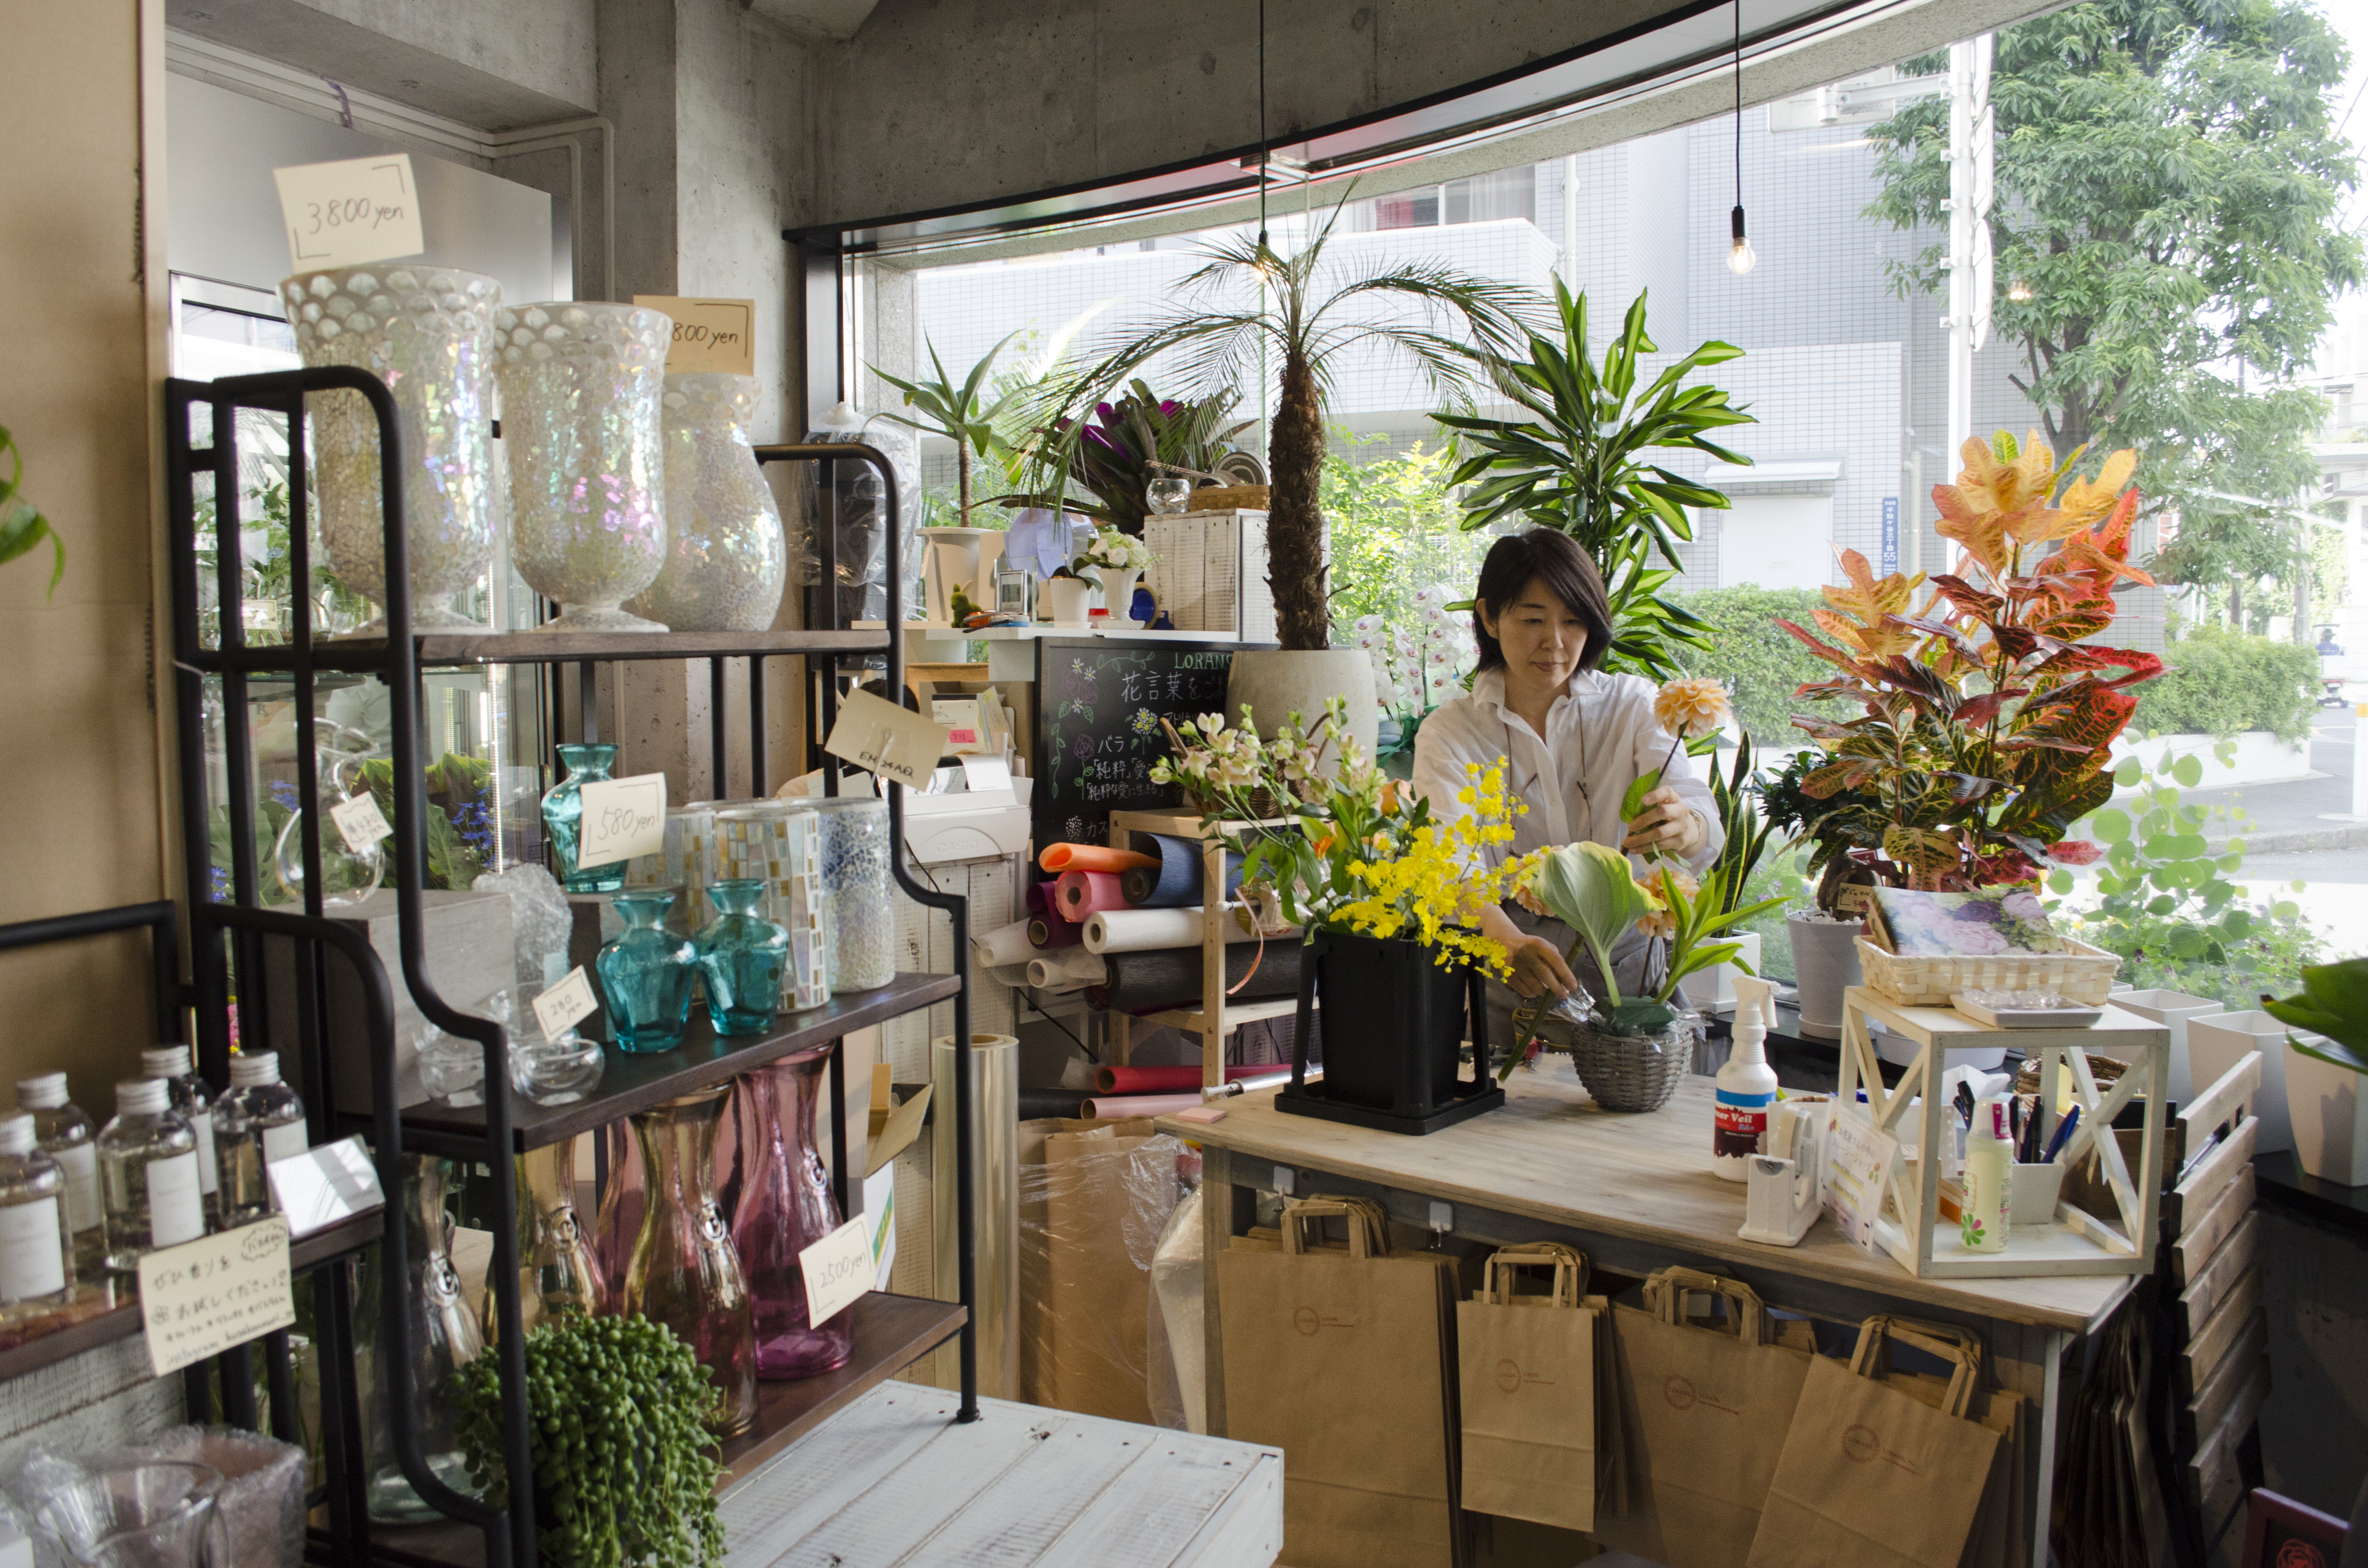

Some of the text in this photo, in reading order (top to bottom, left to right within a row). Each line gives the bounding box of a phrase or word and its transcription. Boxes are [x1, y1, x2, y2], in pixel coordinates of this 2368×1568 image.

[308, 197, 404, 234] 3800 yen
[707, 331, 738, 349] yen
[1883, 552, 1897, 562] 55
[1098, 735, 1125, 754] バラ
[597, 806, 655, 840] 580 yen
[1086, 821, 1109, 837] カス
[937, 838, 979, 854] CASIO
[549, 994, 573, 1017] 280
[1731, 1113, 1752, 1124] Veil
[819, 1251, 867, 1289] 2500 yen
